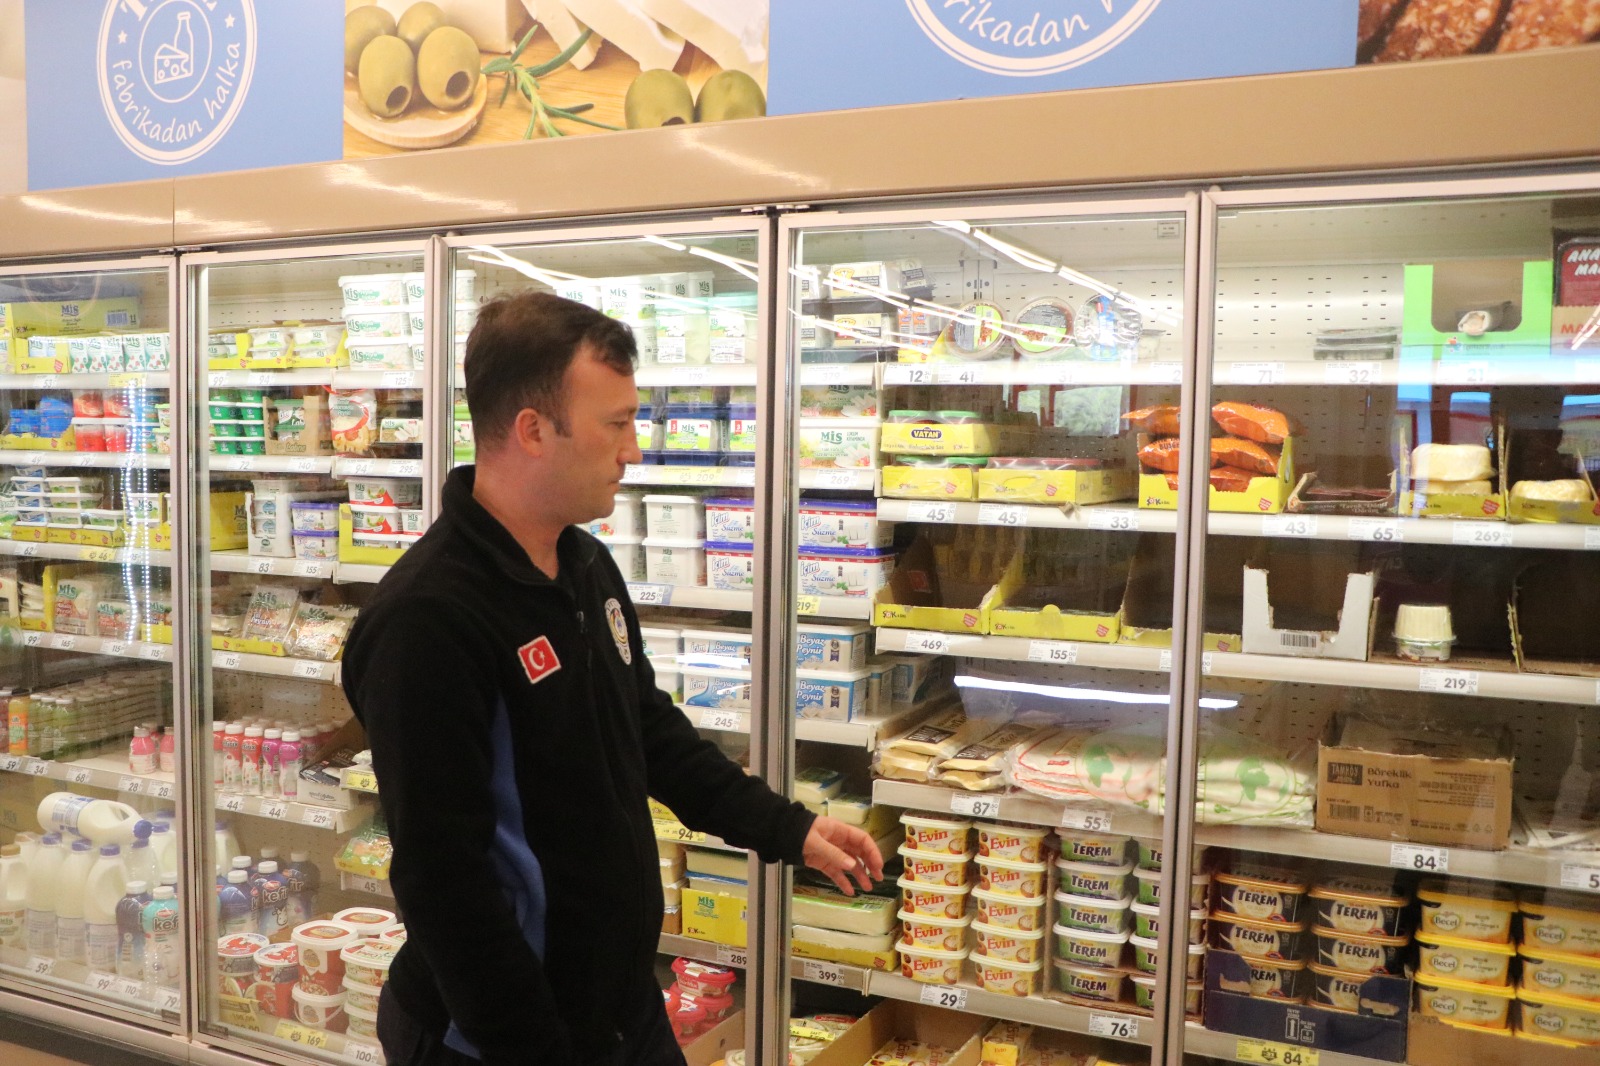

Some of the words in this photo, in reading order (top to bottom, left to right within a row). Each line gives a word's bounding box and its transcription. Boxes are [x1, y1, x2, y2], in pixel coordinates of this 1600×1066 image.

[113, 59, 202, 144] fabrikadan
[206, 41, 241, 120] halka
[909, 370, 924, 383] 12
[959, 371, 975, 383] 41
[1258, 370, 1273, 382] 71
[1349, 370, 1369, 382] 32
[913, 430, 940, 439] VATAN
[926, 509, 946, 521] 45
[998, 511, 1018, 525] 45
[1110, 516, 1130, 530] 33
[1284, 521, 1307, 535] 43
[1372, 527, 1394, 541] 65
[1474, 529, 1500, 543] 269
[258, 563, 270, 574] 83
[306, 565, 318, 575] 155
[640, 591, 656, 602] 225
[27, 636, 38, 645] 99
[60, 639, 71, 648] 165
[800, 634, 825, 647] Beyaz
[920, 638, 942, 651] 469
[112, 644, 122, 653] 115
[797, 644, 823, 656] Peynir
[1049, 649, 1068, 661] 155
[225, 657, 236, 666] 115
[306, 667, 318, 676] 179
[800, 680, 825, 693] Beyaz
[1443, 677, 1467, 690] 219
[797, 690, 823, 702] Peynir
[714, 716, 733, 728] 245
[6, 760, 17, 770] 59
[33, 764, 45, 775] 34
[75, 773, 86, 783] 68
[1367, 767, 1412, 779] Böreklik
[128, 782, 140, 793] 28
[1367, 778, 1400, 789] Yufka
[157, 787, 169, 798] 28
[226, 800, 238, 811] 44
[972, 801, 990, 816] 87
[268, 808, 281, 818] 44
[313, 815, 327, 824] 229
[1083, 815, 1101, 830] 55
[678, 827, 694, 842] 94
[918, 829, 949, 843] Evin
[990, 837, 1020, 850] Evin
[1073, 842, 1112, 857] TEREM
[915, 862, 944, 875] Evin
[1413, 854, 1437, 870] 84
[991, 870, 1020, 883] Evin
[1071, 874, 1109, 891] TEREM
[364, 881, 376, 893] 45
[698, 895, 715, 909] Mis
[915, 893, 945, 907] Evin
[1238, 889, 1278, 906] TEREM
[988, 904, 1018, 917] Evin
[1070, 907, 1108, 925] TEREM
[1336, 903, 1378, 921] TEREM
[1434, 915, 1458, 926] Becel
[914, 926, 943, 939] Evin
[1235, 926, 1275, 944] TEREM
[987, 937, 1016, 950] Evin
[1069, 941, 1107, 958] TEREM
[1338, 942, 1380, 959] TEREM
[730, 953, 747, 965] 289
[913, 958, 943, 971] Evin
[1433, 957, 1456, 969] Becel
[35, 962, 49, 974] 59
[818, 969, 837, 982] 399
[984, 969, 1013, 982] Evin
[1251, 970, 1276, 982] REM
[97, 978, 110, 990] 99
[1070, 974, 1107, 992] TEREM
[1335, 979, 1359, 995] TER
[125, 985, 136, 995] 110
[164, 995, 177, 1008] 79
[939, 992, 958, 1007] 29
[1432, 1000, 1455, 1012] Becel
[1110, 1022, 1128, 1037] 76
[307, 1034, 321, 1047] 169
[355, 1049, 372, 1063] 100
[1283, 1051, 1302, 1066] 84
